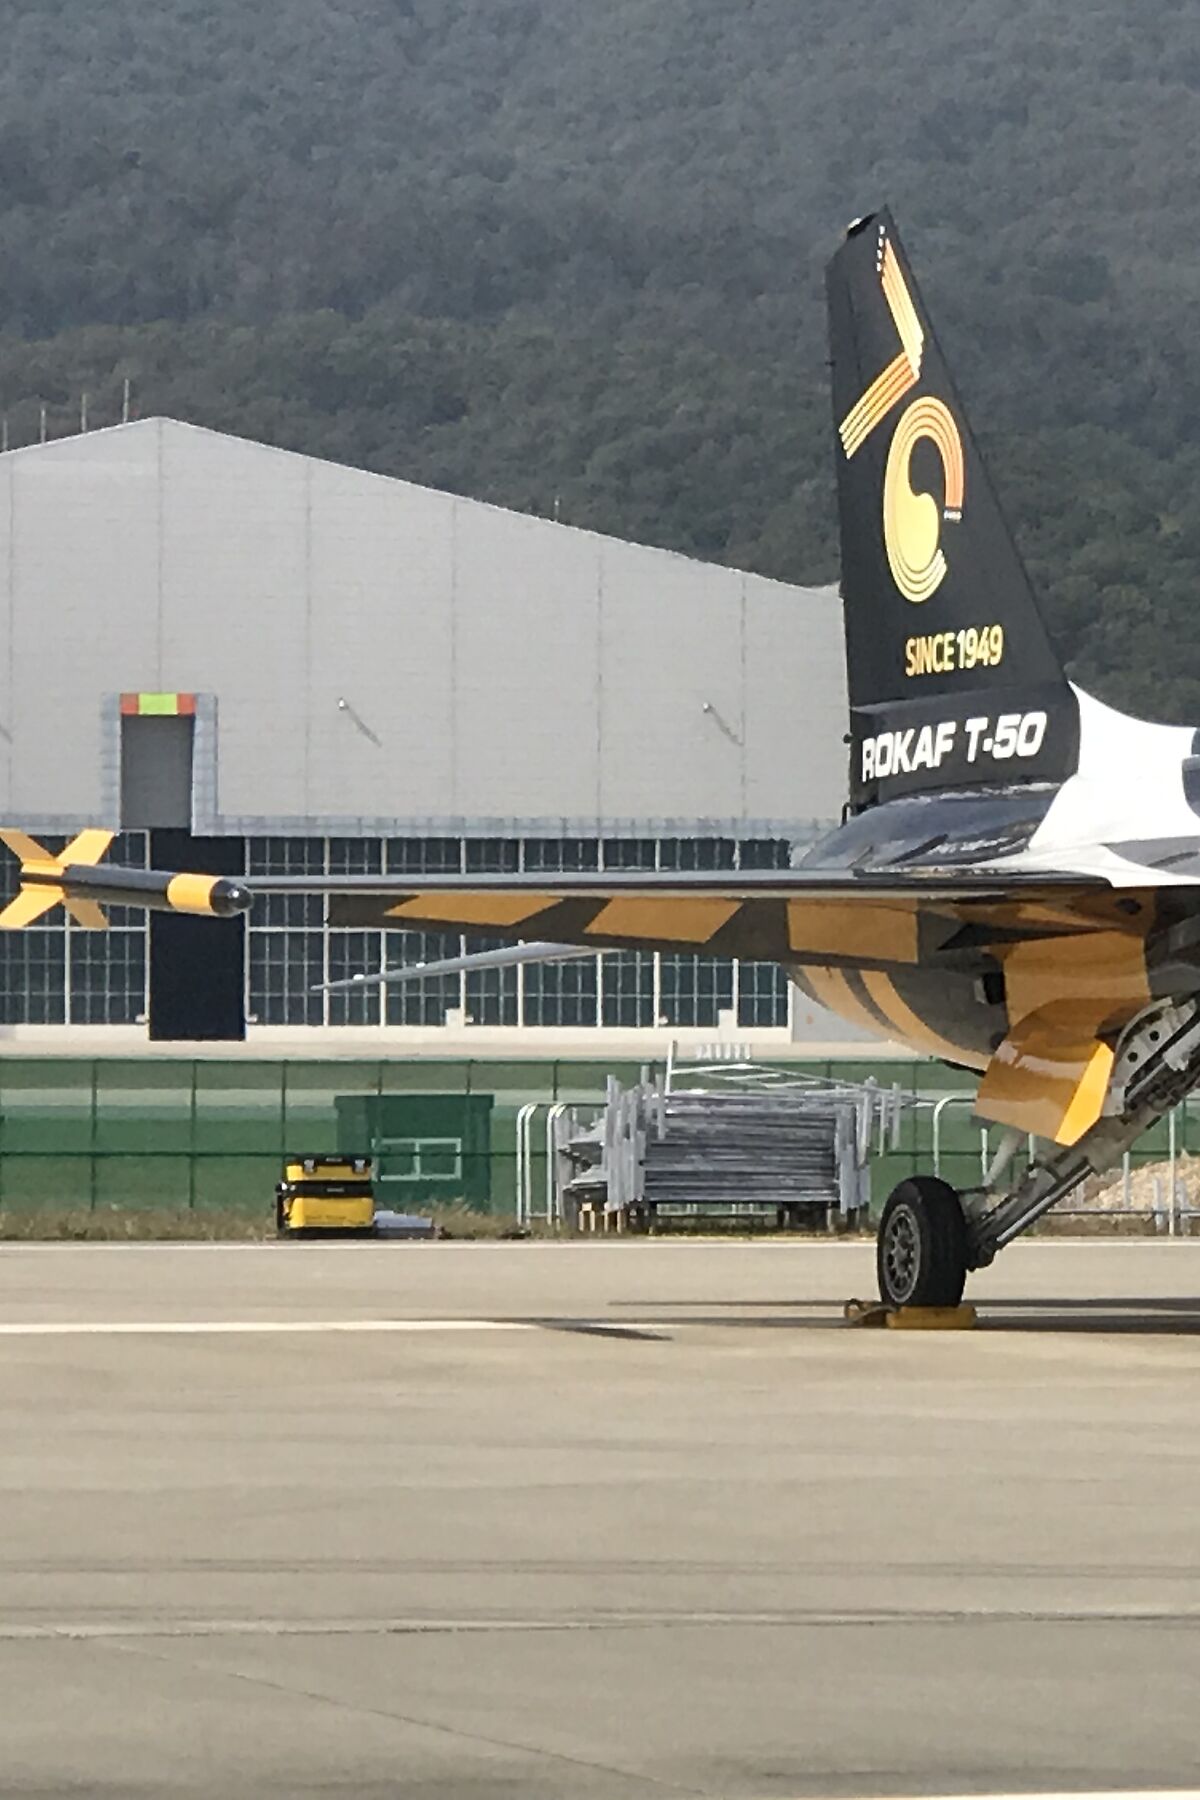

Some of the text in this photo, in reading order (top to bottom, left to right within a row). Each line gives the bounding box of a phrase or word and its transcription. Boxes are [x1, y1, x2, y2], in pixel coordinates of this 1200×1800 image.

[905, 624, 1004, 677] SINCE 1949
[861, 721, 956, 782] ROKAF
